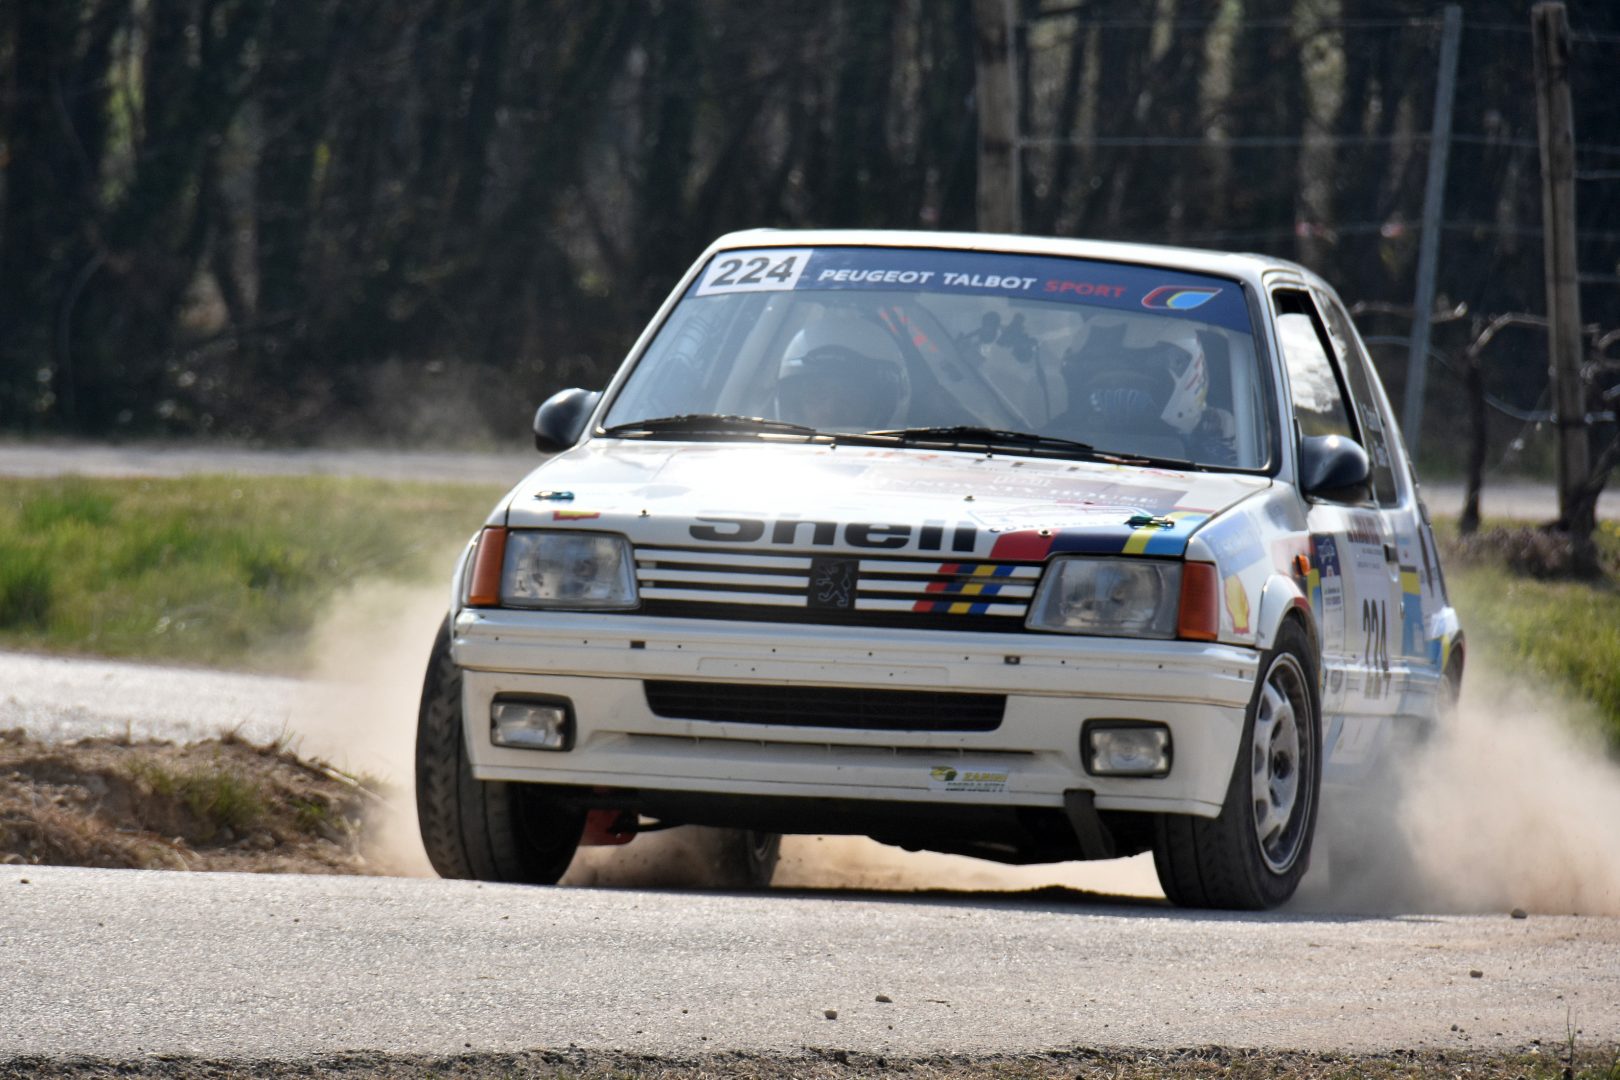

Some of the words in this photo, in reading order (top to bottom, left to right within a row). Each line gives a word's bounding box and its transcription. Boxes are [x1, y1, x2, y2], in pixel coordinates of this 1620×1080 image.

[709, 256, 798, 287] 224
[817, 269, 934, 284] PEUGEOT
[943, 272, 1037, 290] TALBOT
[1044, 280, 1127, 299] SPORT
[689, 512, 978, 553] Shell
